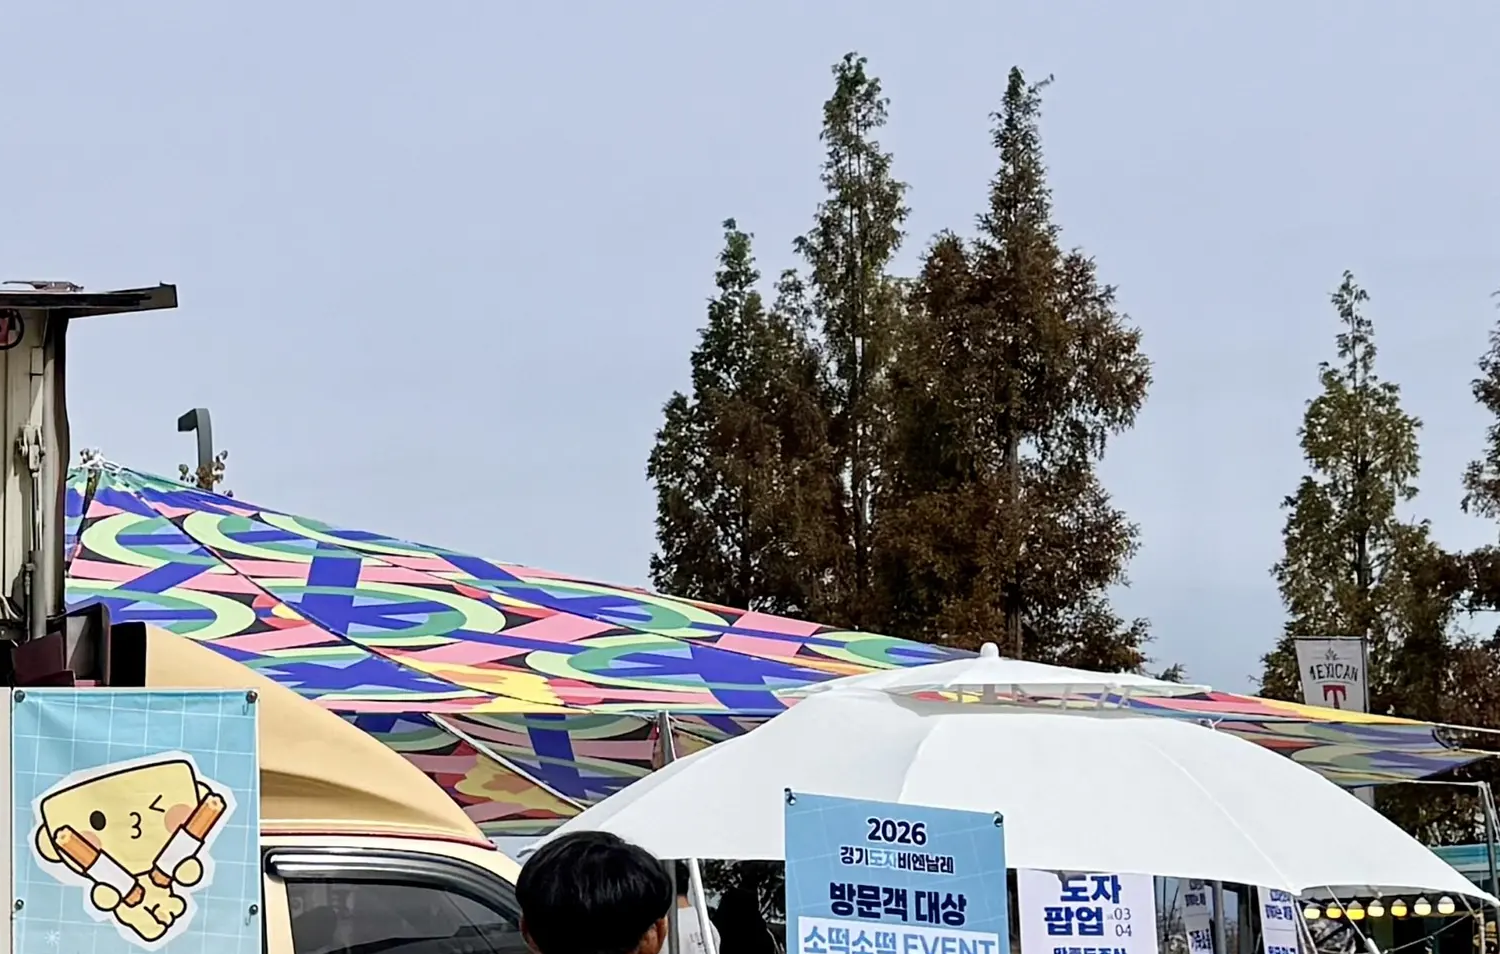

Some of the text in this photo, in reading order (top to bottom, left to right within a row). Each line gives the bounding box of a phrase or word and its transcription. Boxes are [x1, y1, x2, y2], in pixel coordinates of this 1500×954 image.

[867, 817, 927, 846] 2026
[840, 846, 954, 875] 경기도자비엔날레
[829, 882, 968, 926] 방문객 대상
[1060, 874, 1122, 904] 도자
[1044, 906, 1104, 936] 팝업
